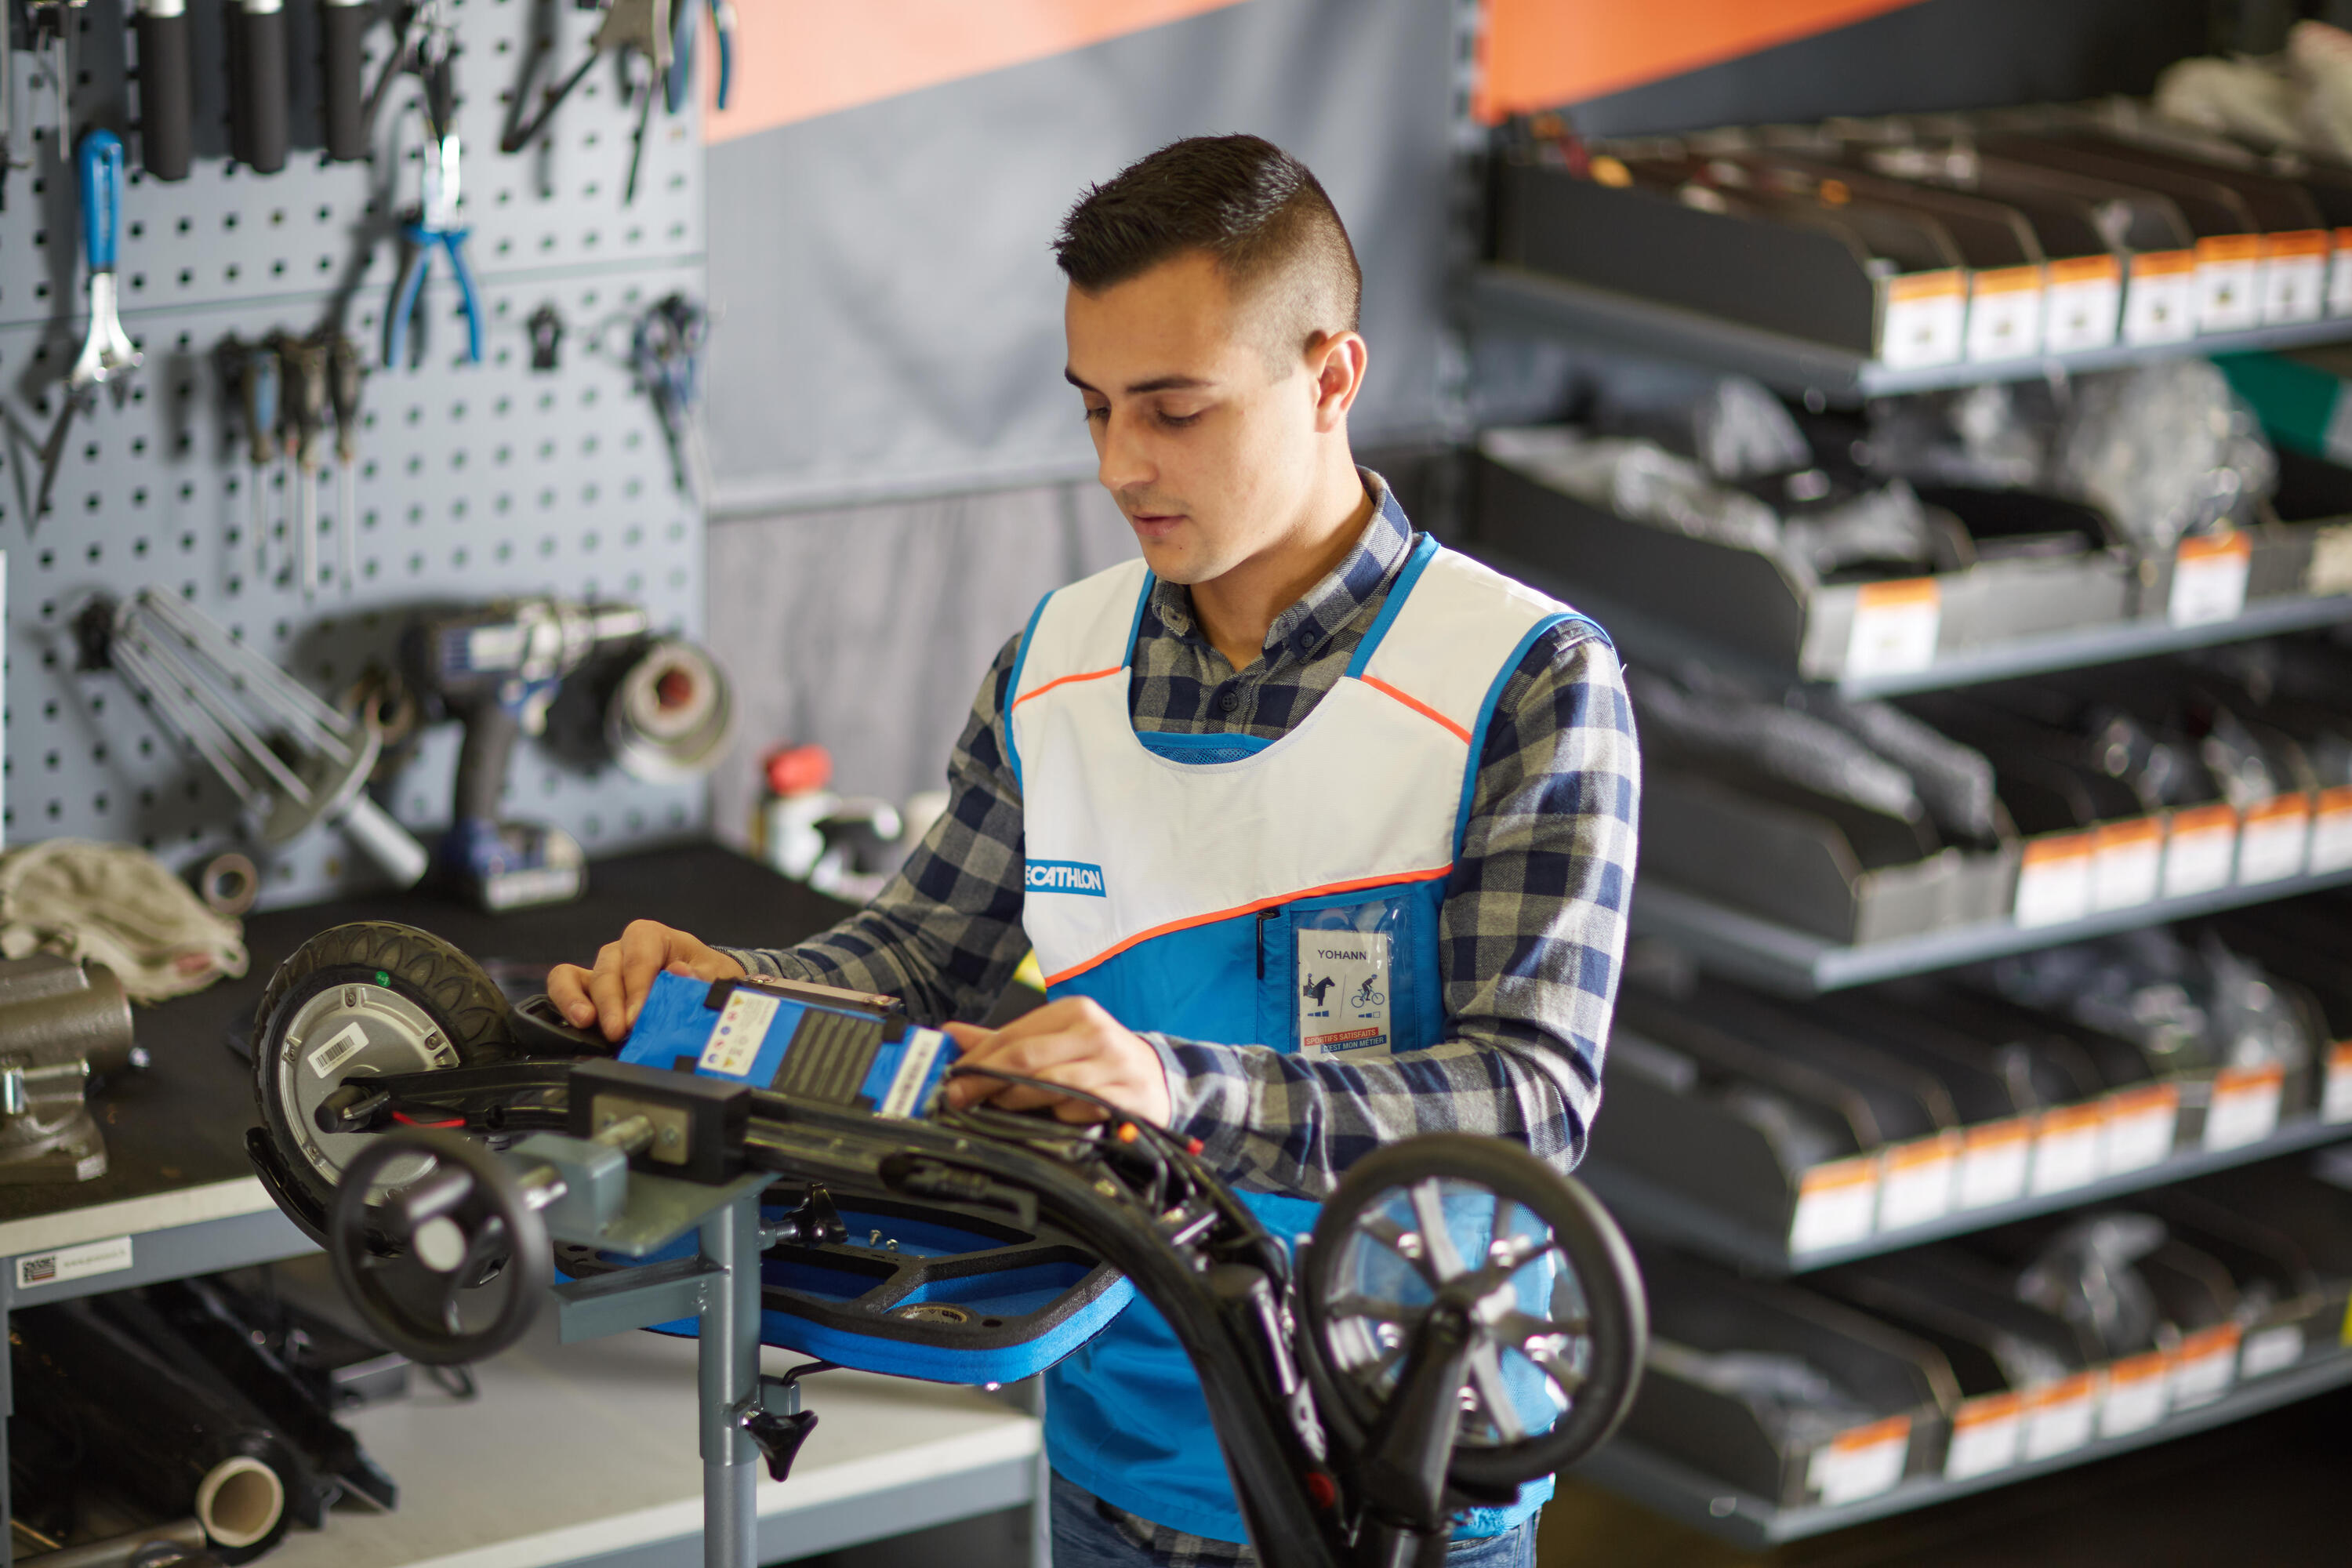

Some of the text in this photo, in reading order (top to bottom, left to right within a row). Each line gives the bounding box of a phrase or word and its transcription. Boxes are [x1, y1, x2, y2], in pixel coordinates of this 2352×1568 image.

[1025, 865, 1102, 891] ECATHLON
[1318, 949, 1367, 960] YOHANN
[1305, 1029, 1376, 1045] SPORTIFS SATISFAITS
[1359, 1036, 1384, 1047] MÉTIER
